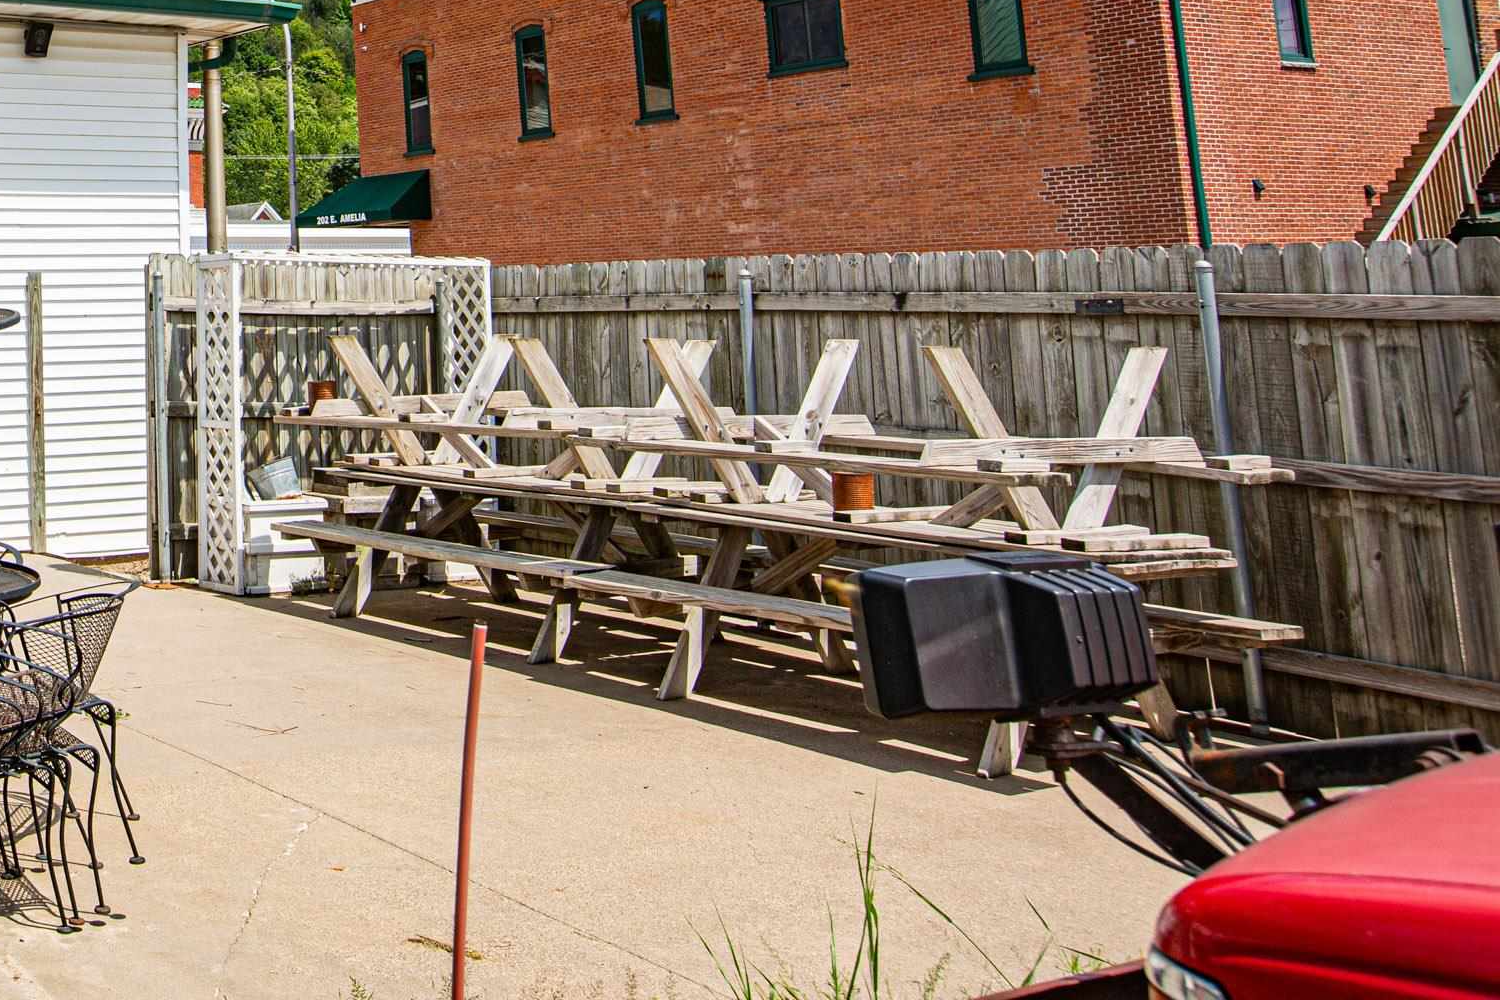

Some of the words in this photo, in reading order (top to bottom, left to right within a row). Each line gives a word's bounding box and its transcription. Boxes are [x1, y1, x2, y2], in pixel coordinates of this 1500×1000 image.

[316, 216, 329, 224] 202
[330, 215, 337, 223] E.
[340, 212, 366, 223] AMELIA
